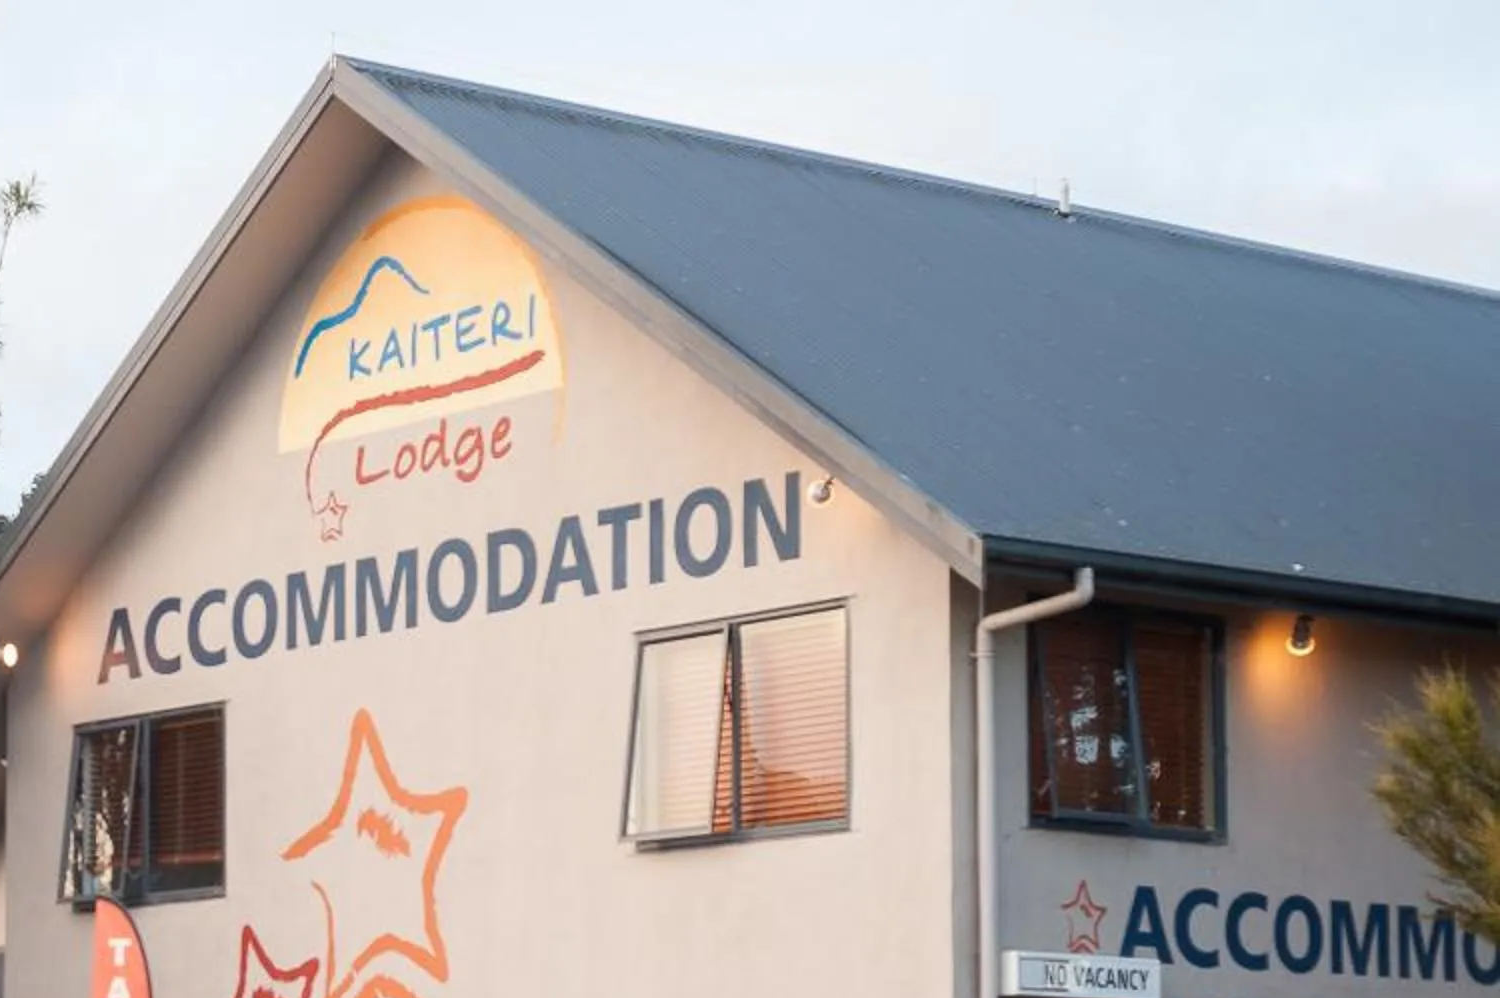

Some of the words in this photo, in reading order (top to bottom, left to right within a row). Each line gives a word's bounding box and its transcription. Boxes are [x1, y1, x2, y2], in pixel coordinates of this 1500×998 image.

[349, 293, 538, 381] KAITERI
[355, 414, 513, 483] Lodge
[97, 470, 803, 685] ACCOMMODATION
[1044, 962, 1068, 987] NO
[1073, 964, 1150, 991] VACANCY
